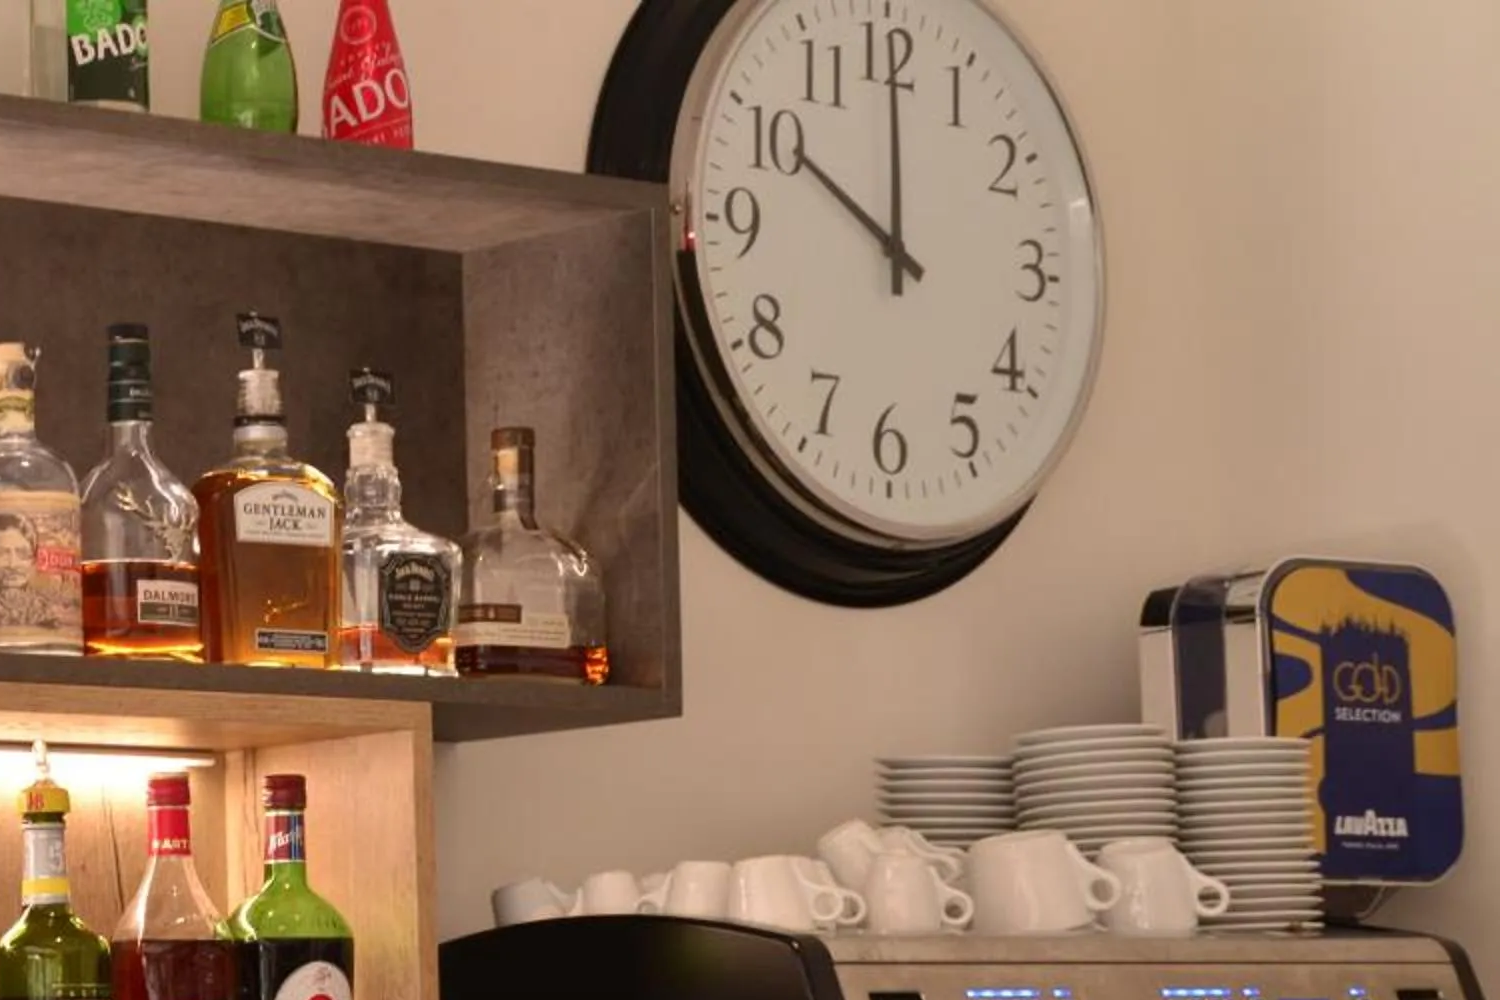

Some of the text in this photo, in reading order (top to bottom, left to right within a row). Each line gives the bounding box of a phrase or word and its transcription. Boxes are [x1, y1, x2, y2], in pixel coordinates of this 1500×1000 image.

[71, 23, 147, 66] BADO
[800, 38, 847, 109] 11
[859, 21, 915, 92] 12
[324, 68, 408, 140] ADO
[946, 65, 966, 128] 1
[748, 105, 805, 176] 10
[988, 134, 1019, 198] 2
[724, 187, 761, 259] 9
[1015, 239, 1046, 302] 3
[748, 293, 785, 360] 8
[990, 327, 1025, 393] 4
[810, 367, 841, 436] 7
[949, 392, 980, 458] 5
[873, 402, 908, 475] 6
[243, 502, 327, 519] GENTLEMAN
[269, 517, 303, 531] JACK
[1334, 697, 1403, 723] SELECTION
